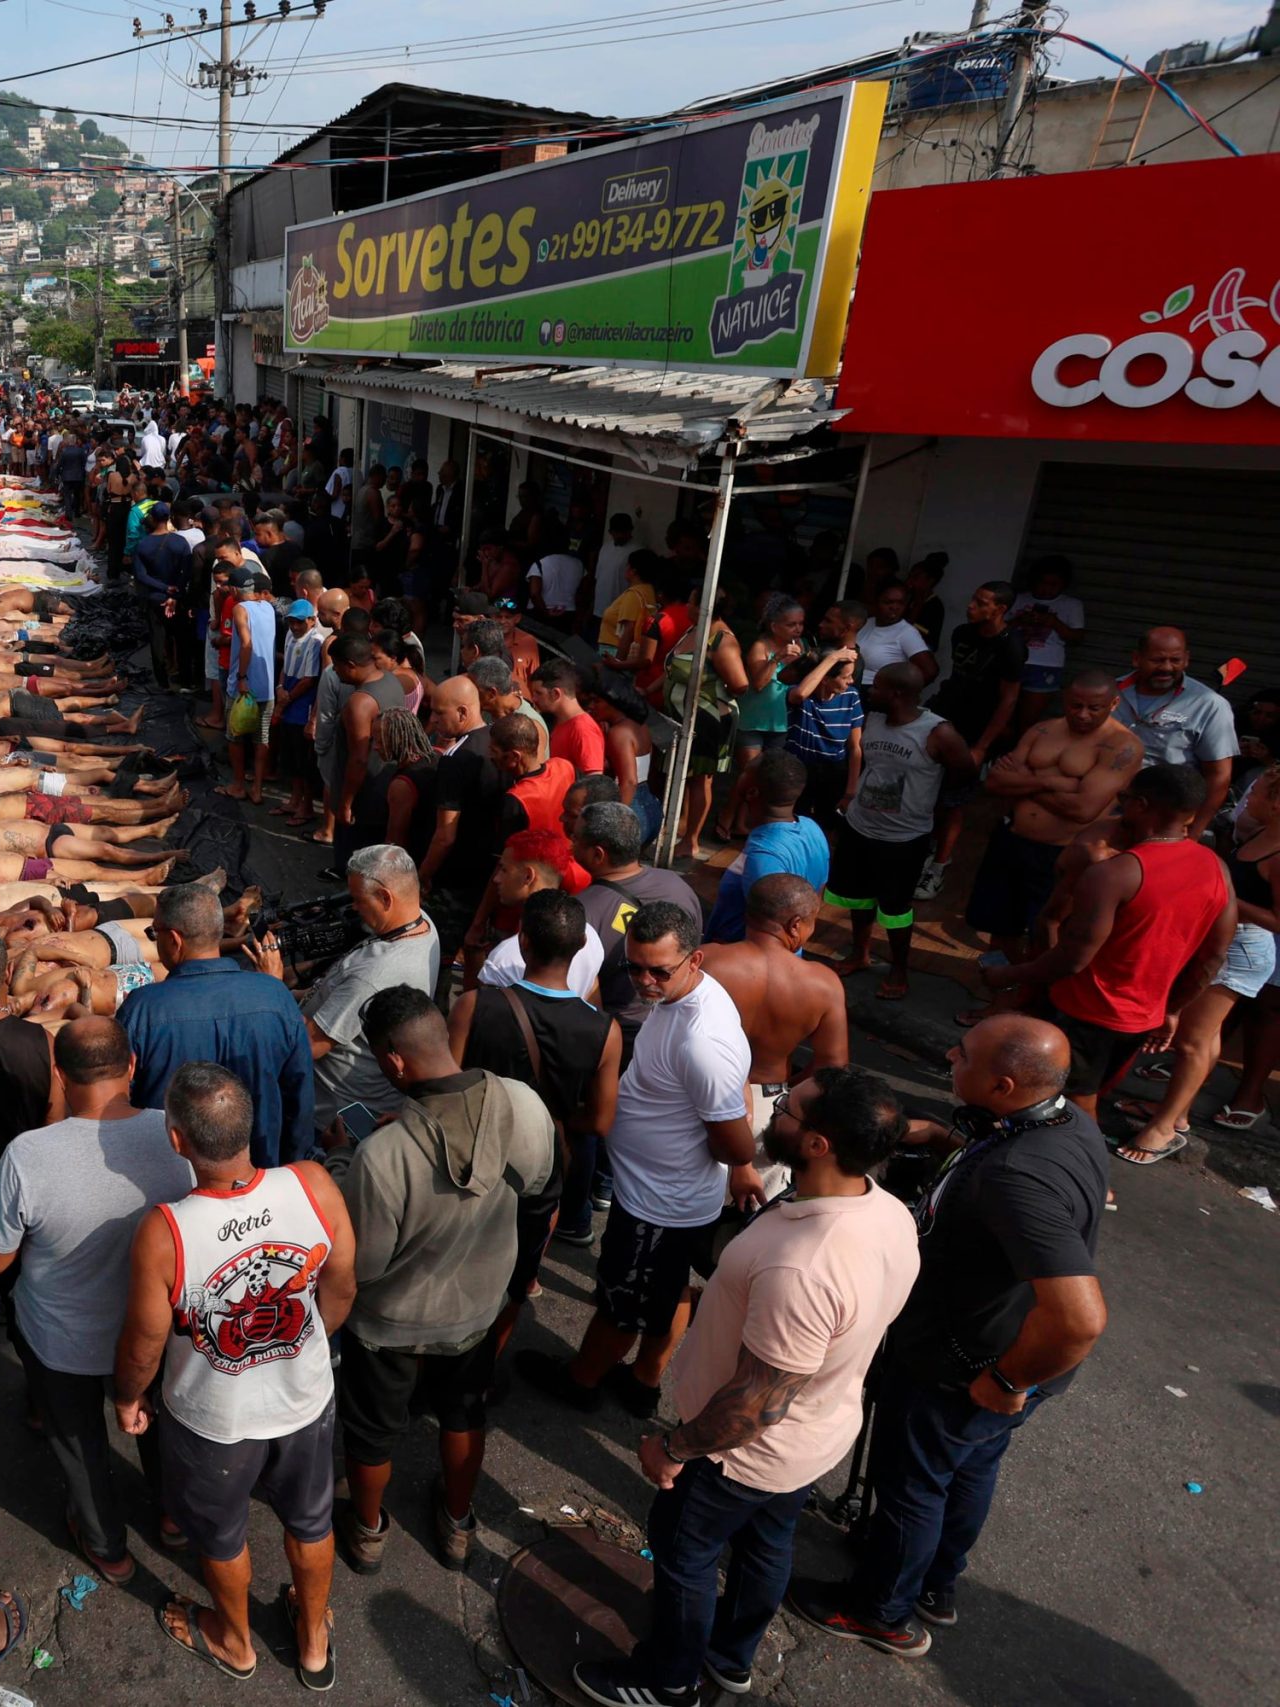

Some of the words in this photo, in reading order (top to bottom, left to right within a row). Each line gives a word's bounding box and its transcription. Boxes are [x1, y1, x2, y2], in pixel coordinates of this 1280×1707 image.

[608, 177, 662, 204] Delivery
[548, 233, 568, 261] 21
[570, 200, 726, 260] 99134-9772
[332, 202, 536, 299] Sorvetes
[409, 315, 445, 342] Direto
[448, 312, 467, 342] da
[467, 311, 525, 344] fábrica
[717, 283, 792, 343] NATUICE
[568, 320, 694, 344] @natuicevilacruzeiro
[217, 1208, 273, 1242] Retrô
[204, 1338, 251, 1372] EXÉRCITO
[255, 1345, 296, 1364] RUBRO
